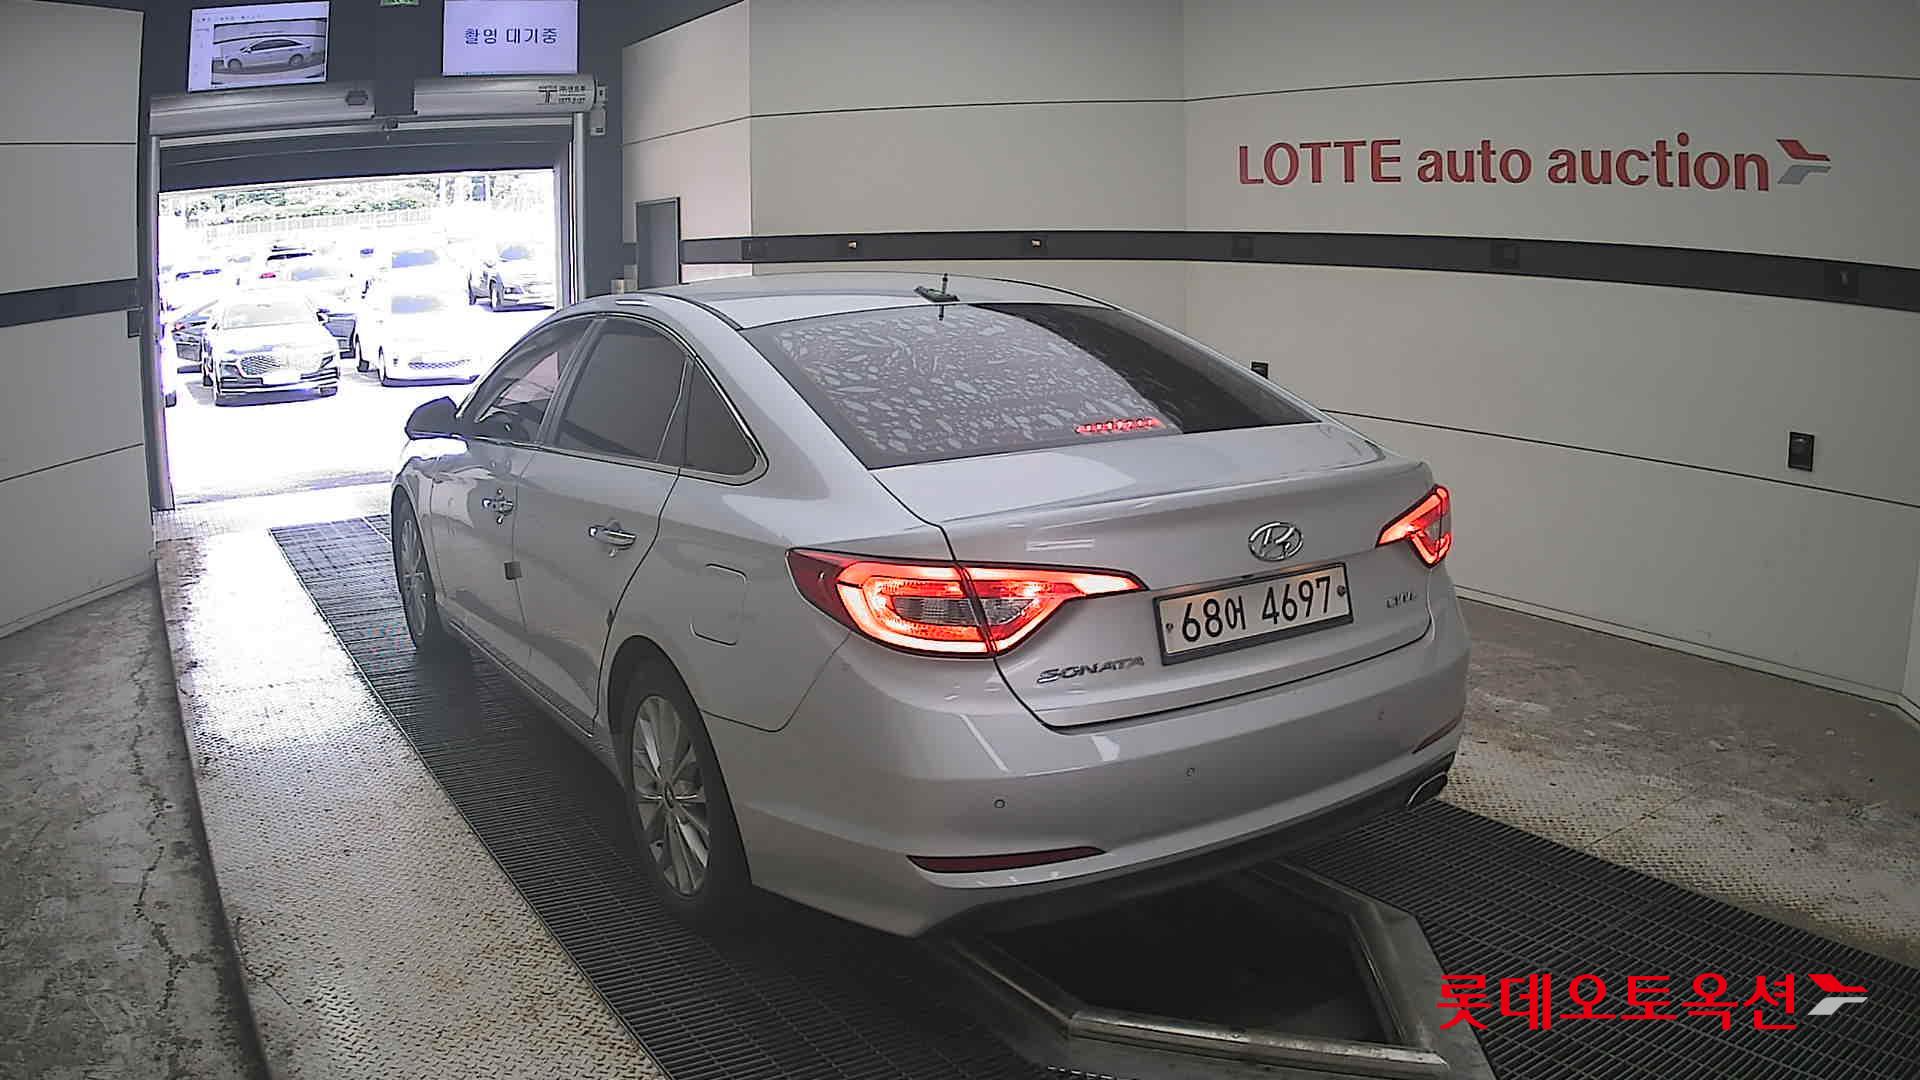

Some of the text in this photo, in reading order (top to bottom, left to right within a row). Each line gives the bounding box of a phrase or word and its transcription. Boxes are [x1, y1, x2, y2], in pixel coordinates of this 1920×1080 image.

[506, 28, 558, 44] 대기중
[1239, 132, 1769, 191] LOTTE auto auction
[1182, 575, 1331, 642] 68어 4697
[1037, 656, 1144, 684] SONATA
